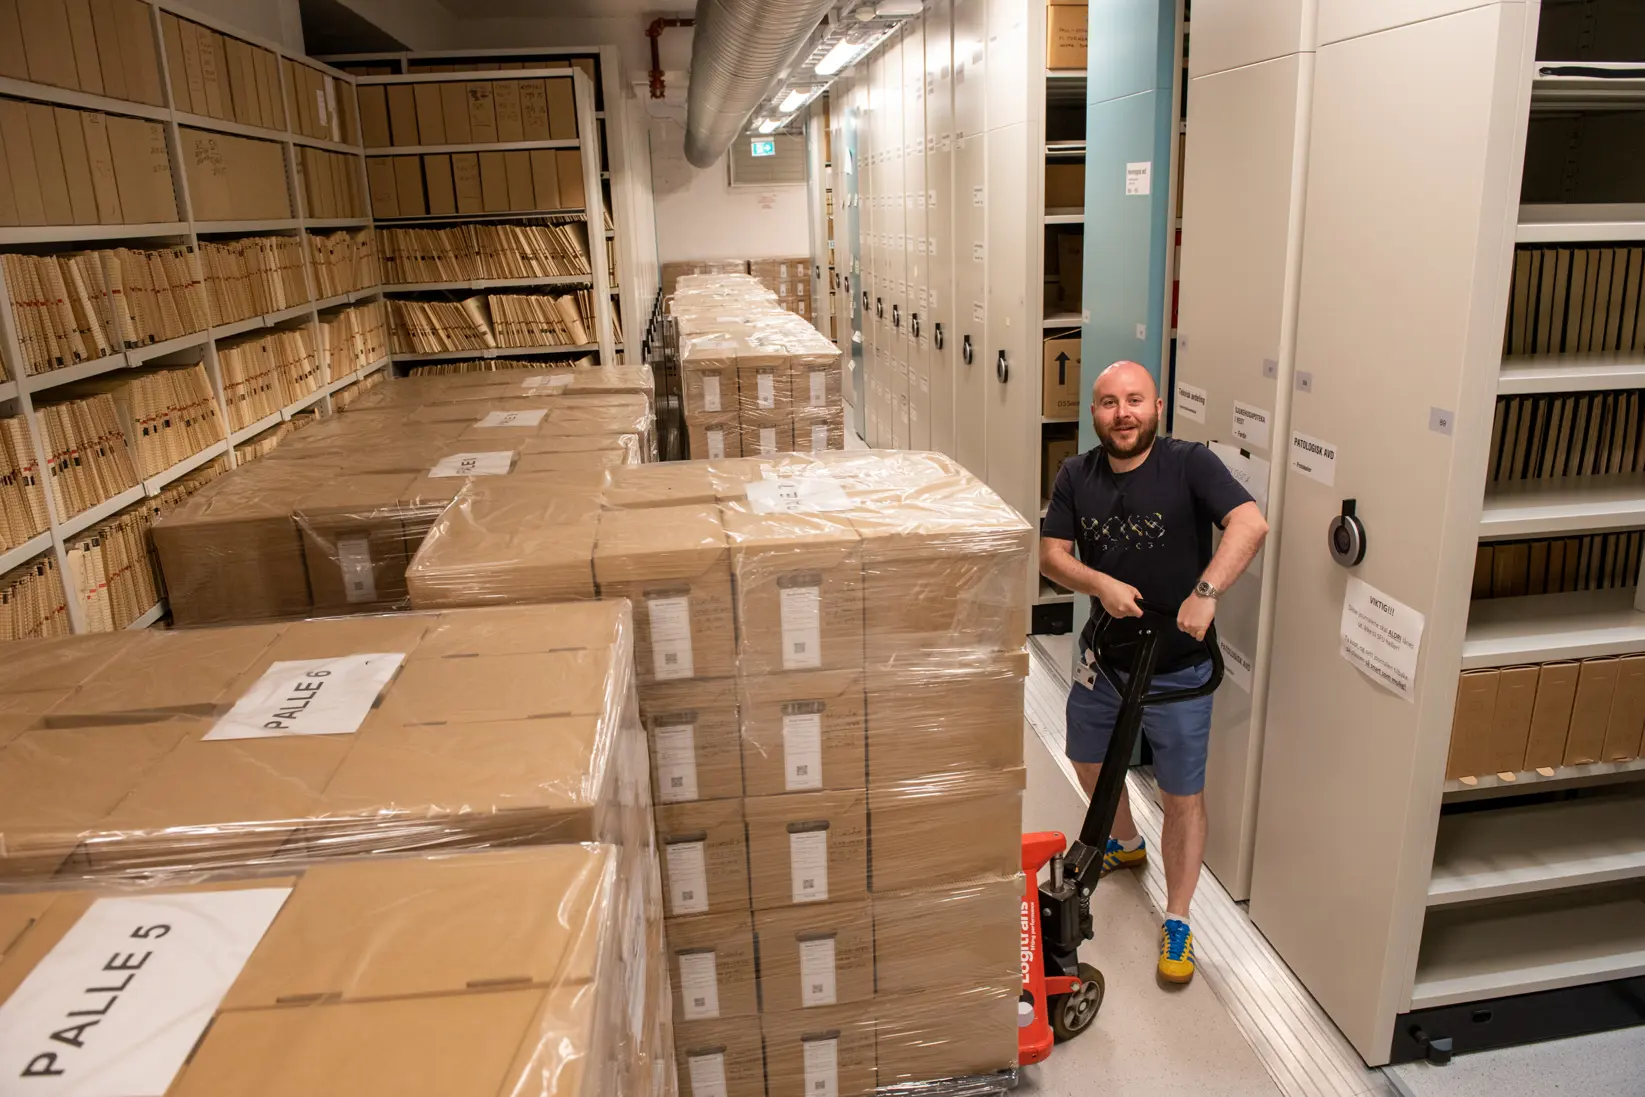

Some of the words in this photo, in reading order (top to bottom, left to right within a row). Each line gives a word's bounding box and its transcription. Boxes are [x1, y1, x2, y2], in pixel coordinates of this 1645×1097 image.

[1293, 437, 1323, 456] PATOLOGISK
[1323, 449, 1335, 460] AVD
[1369, 595, 1395, 616] VIKTIG!!!
[1388, 629, 1402, 642] ALDRI
[264, 683, 324, 731] PALLE
[306, 669, 332, 680] 6
[20, 951, 153, 1078] PALLE
[131, 922, 173, 945] 5
